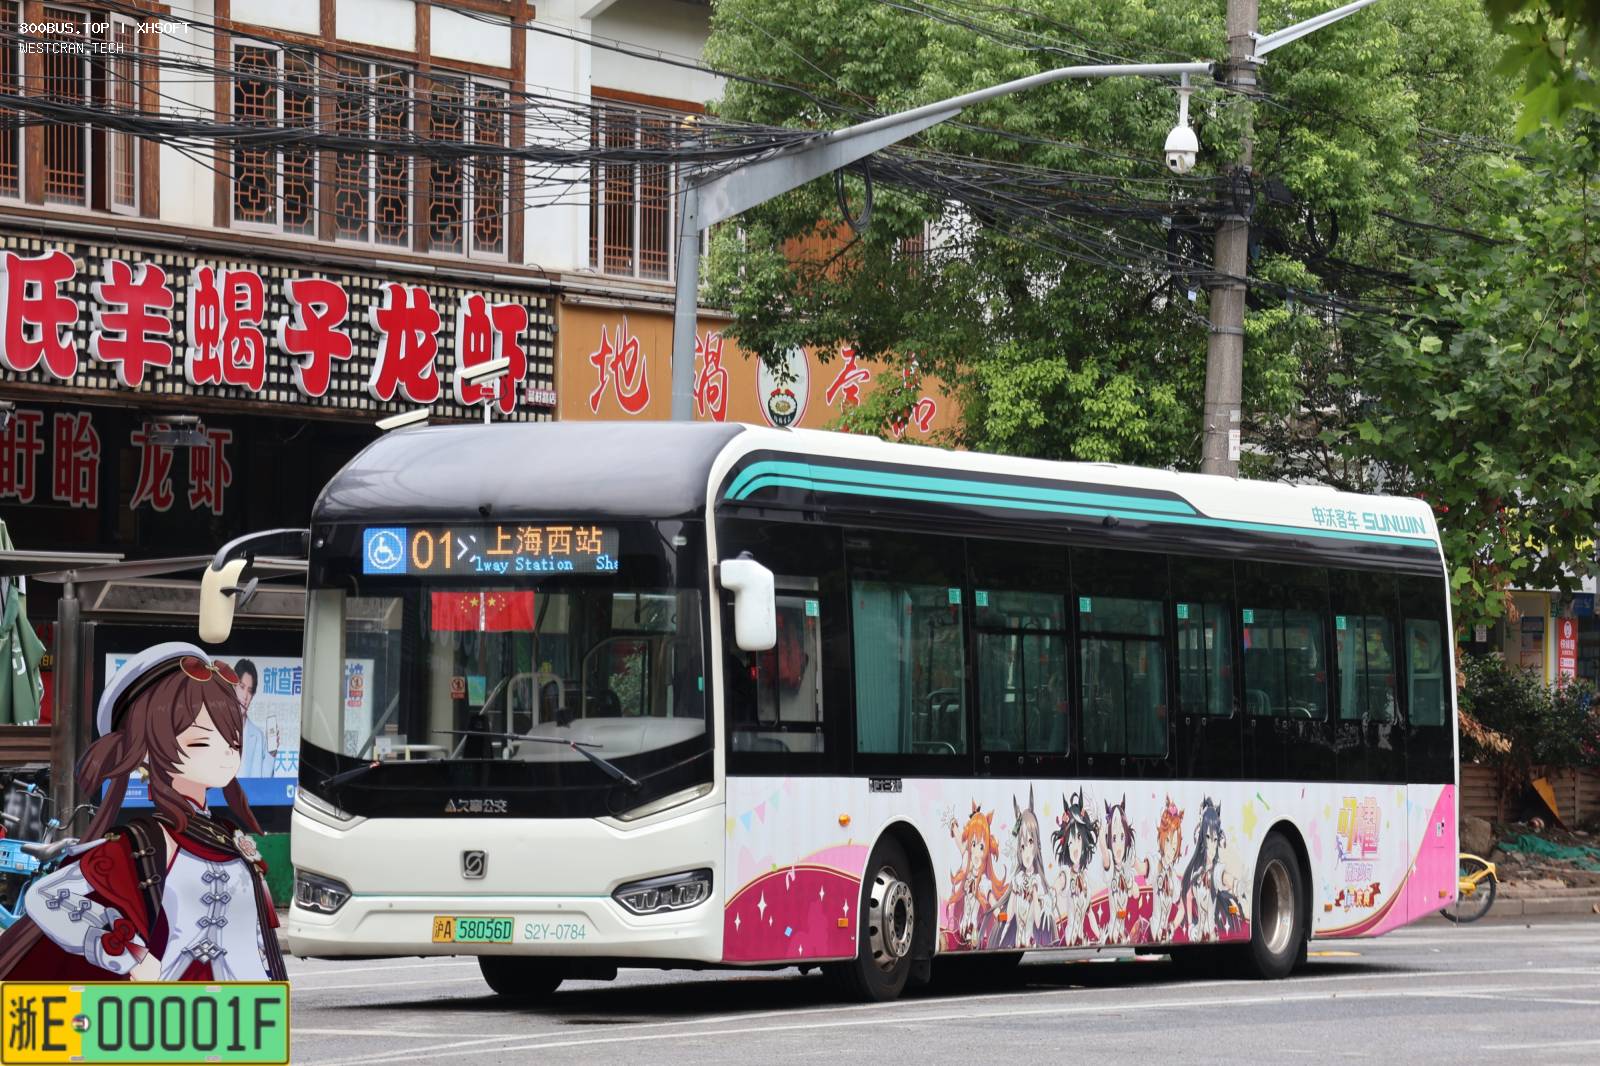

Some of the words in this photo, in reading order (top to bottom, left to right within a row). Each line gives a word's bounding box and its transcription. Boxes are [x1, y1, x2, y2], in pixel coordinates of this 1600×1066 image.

[0, 249, 528, 415] 氏羊蝎子龙虾
[1312, 506, 1360, 530] 申沃客车
[1363, 512, 1426, 534] SUNWIN
[412, 530, 452, 569] 01
[487, 526, 603, 556] 上海西站
[515, 556, 573, 571] Station
[524, 923, 586, 940] S2Y-0784
